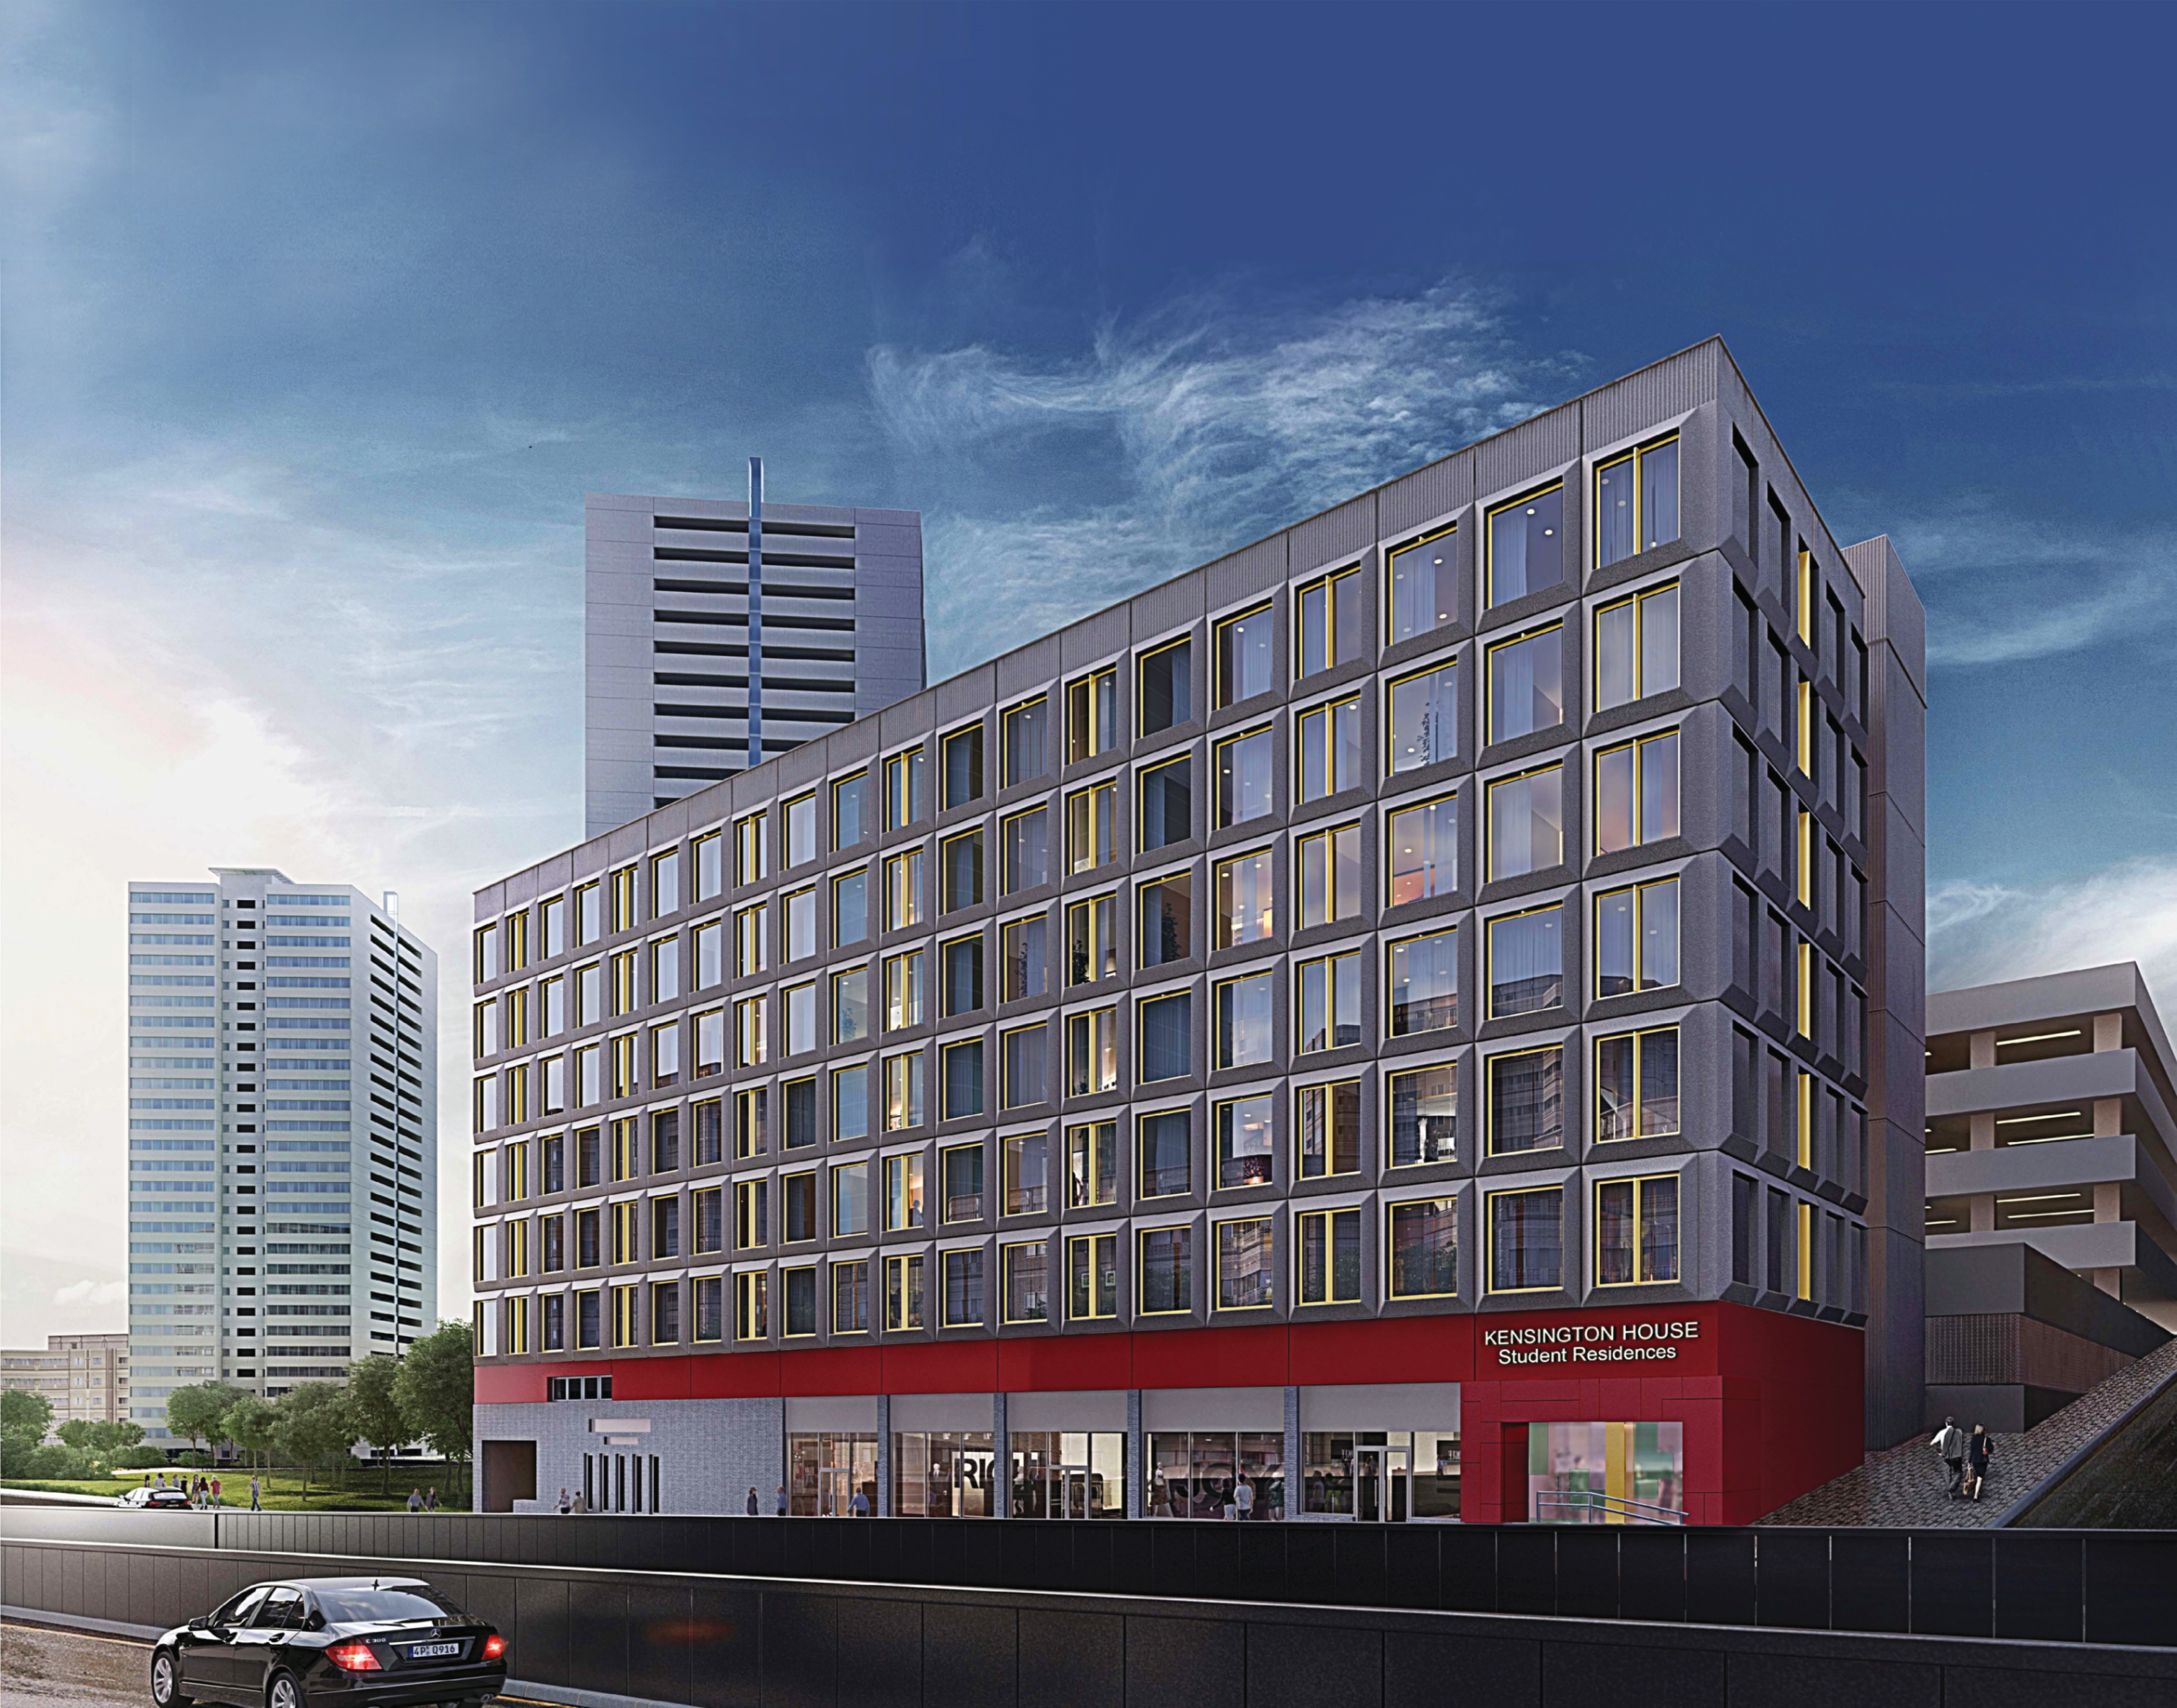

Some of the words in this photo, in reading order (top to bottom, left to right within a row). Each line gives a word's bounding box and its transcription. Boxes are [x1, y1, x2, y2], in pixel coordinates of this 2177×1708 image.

[1485, 1326, 1614, 1345] KENSINGTON
[1623, 1322, 1699, 1340] HOUSE
[1498, 1349, 1567, 1364] Student
[1573, 1346, 1677, 1362] Residences
